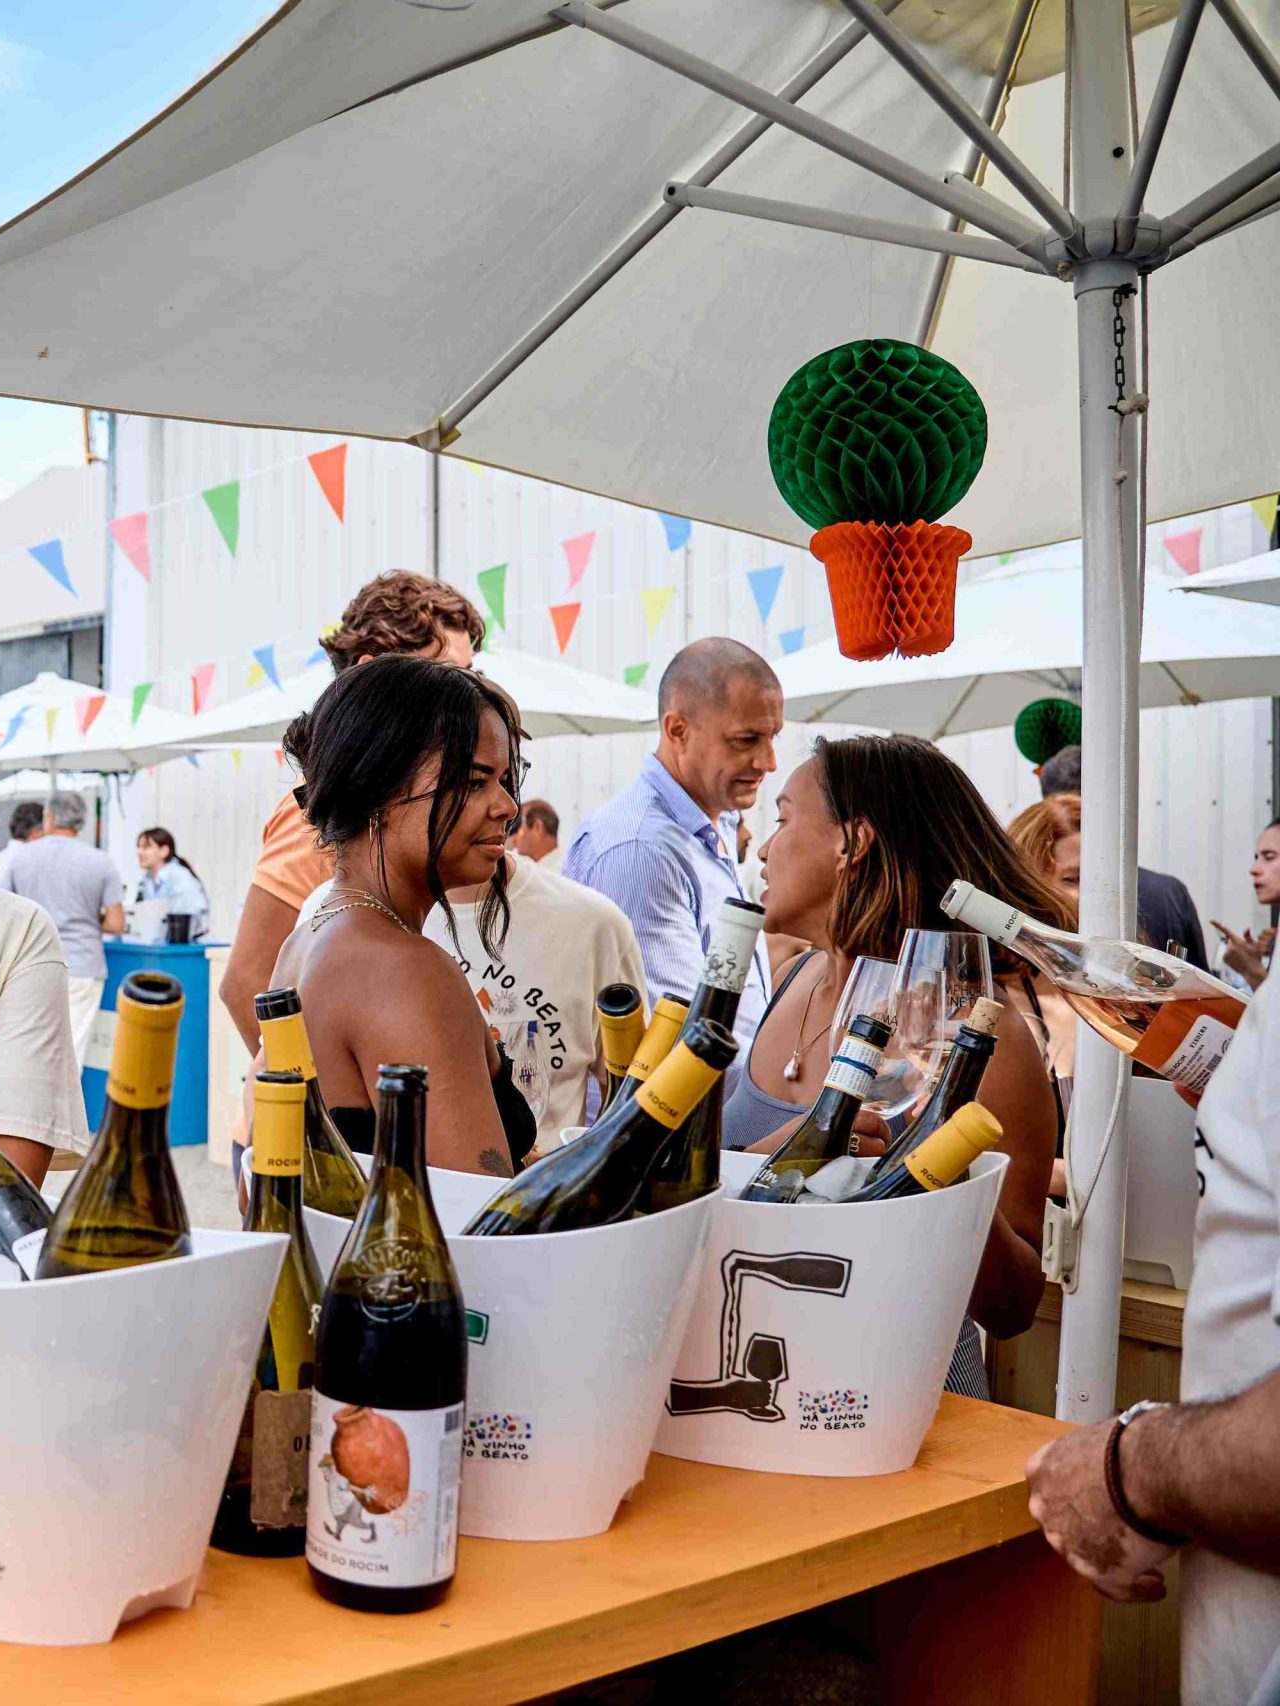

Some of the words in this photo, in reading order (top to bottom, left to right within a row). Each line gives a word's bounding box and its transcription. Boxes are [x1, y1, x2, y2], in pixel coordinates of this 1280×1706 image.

[482, 964, 516, 989] NO
[523, 987, 567, 1070] BEATO
[646, 1090, 680, 1118] ROCIM
[802, 1412, 818, 1422] HÁ
[825, 1413, 864, 1422] VINHO
[800, 1422, 817, 1431] NO
[824, 1421, 866, 1431] BEATO
[483, 1441, 526, 1451] VINHO
[481, 1449, 528, 1460] BEATO
[331, 1553, 346, 1566] DO
[349, 1559, 390, 1572] ROCIM
